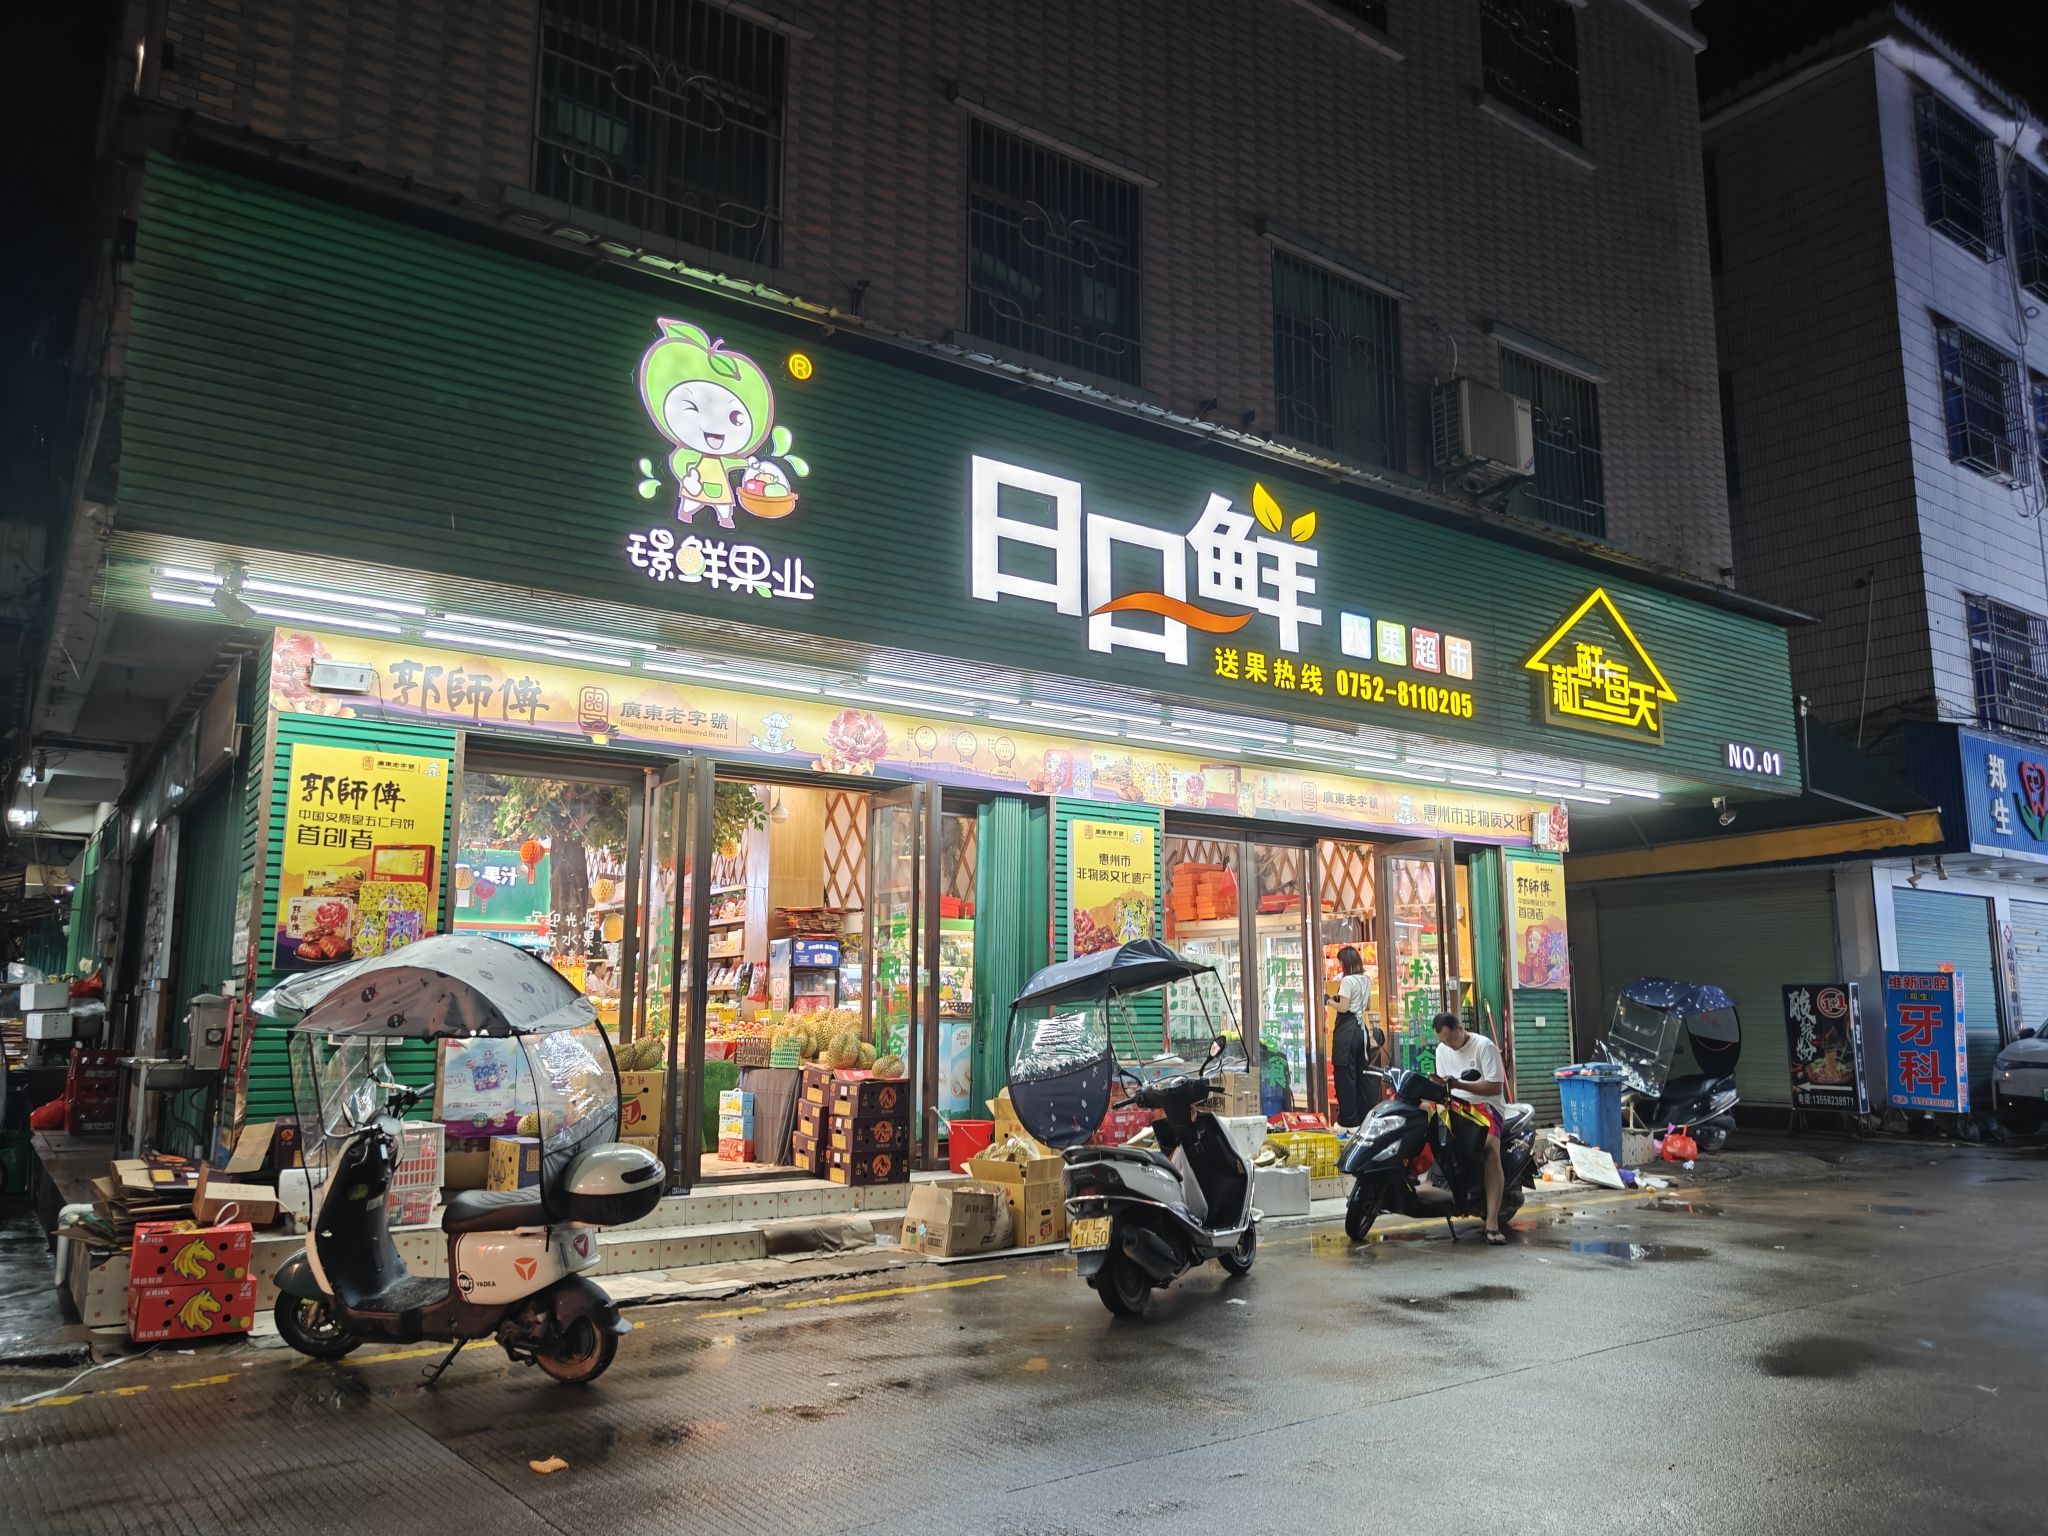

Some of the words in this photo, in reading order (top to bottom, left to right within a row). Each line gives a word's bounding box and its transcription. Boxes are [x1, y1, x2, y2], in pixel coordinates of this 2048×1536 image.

[1343, 616, 1472, 680] 水果超市
[1215, 646, 1324, 696] 送果热线
[1337, 669, 1473, 719] 0752-8110205
[620, 701, 729, 731] 廣東老字號
[620, 719, 660, 734] Guangdong
[708, 731, 728, 740] Brand
[1728, 743, 1782, 776] NO.01
[300, 772, 406, 813] 郭師傅
[1987, 753, 2013, 836] 郑生
[297, 823, 374, 850] 首创者
[1076, 867, 1152, 885] 非物质文化遗产
[1099, 853, 1132, 867] 惠州市
[1887, 975, 1950, 991] 维新口腔
[1788, 987, 1818, 1062] 酸辣粉
[1897, 1003, 1947, 1096] 牙科
